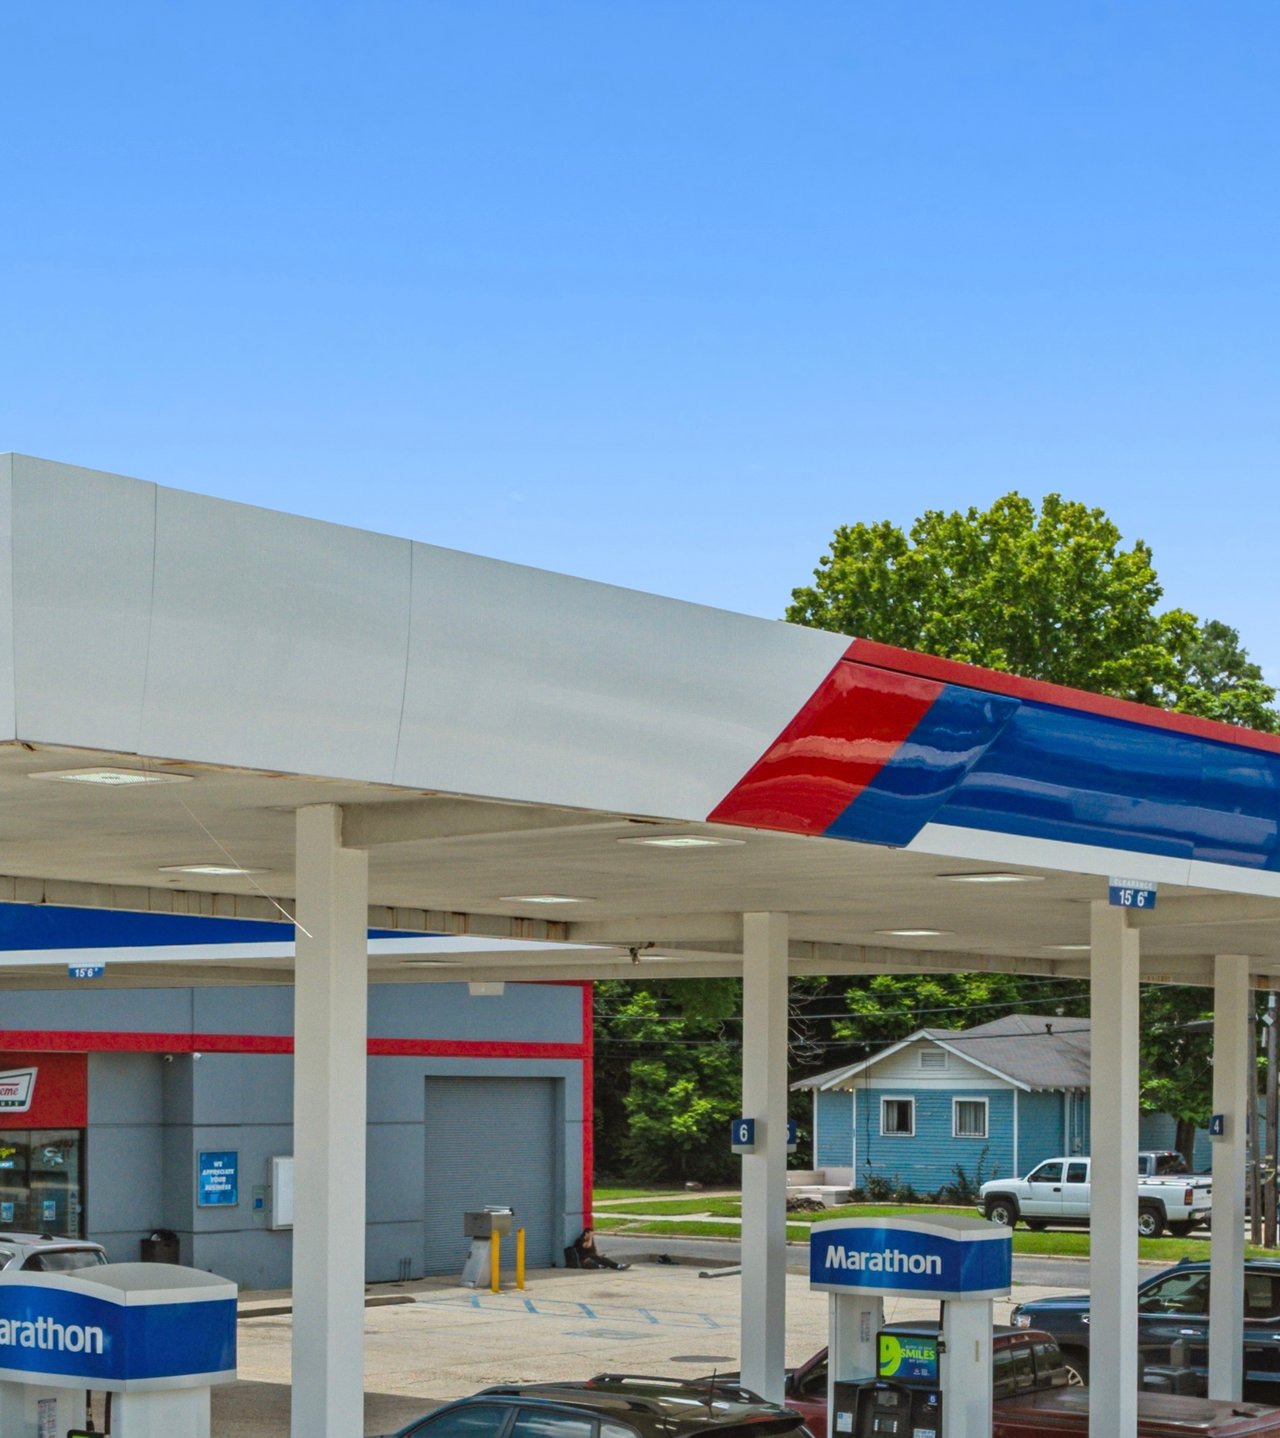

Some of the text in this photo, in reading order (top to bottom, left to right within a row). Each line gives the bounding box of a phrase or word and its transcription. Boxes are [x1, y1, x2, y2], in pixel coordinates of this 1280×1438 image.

[740, 1124, 749, 1142] 6
[1214, 1120, 1220, 1133] 4
[825, 1245, 942, 1275] Marathon
[900, 1348, 935, 1360] SMILES
